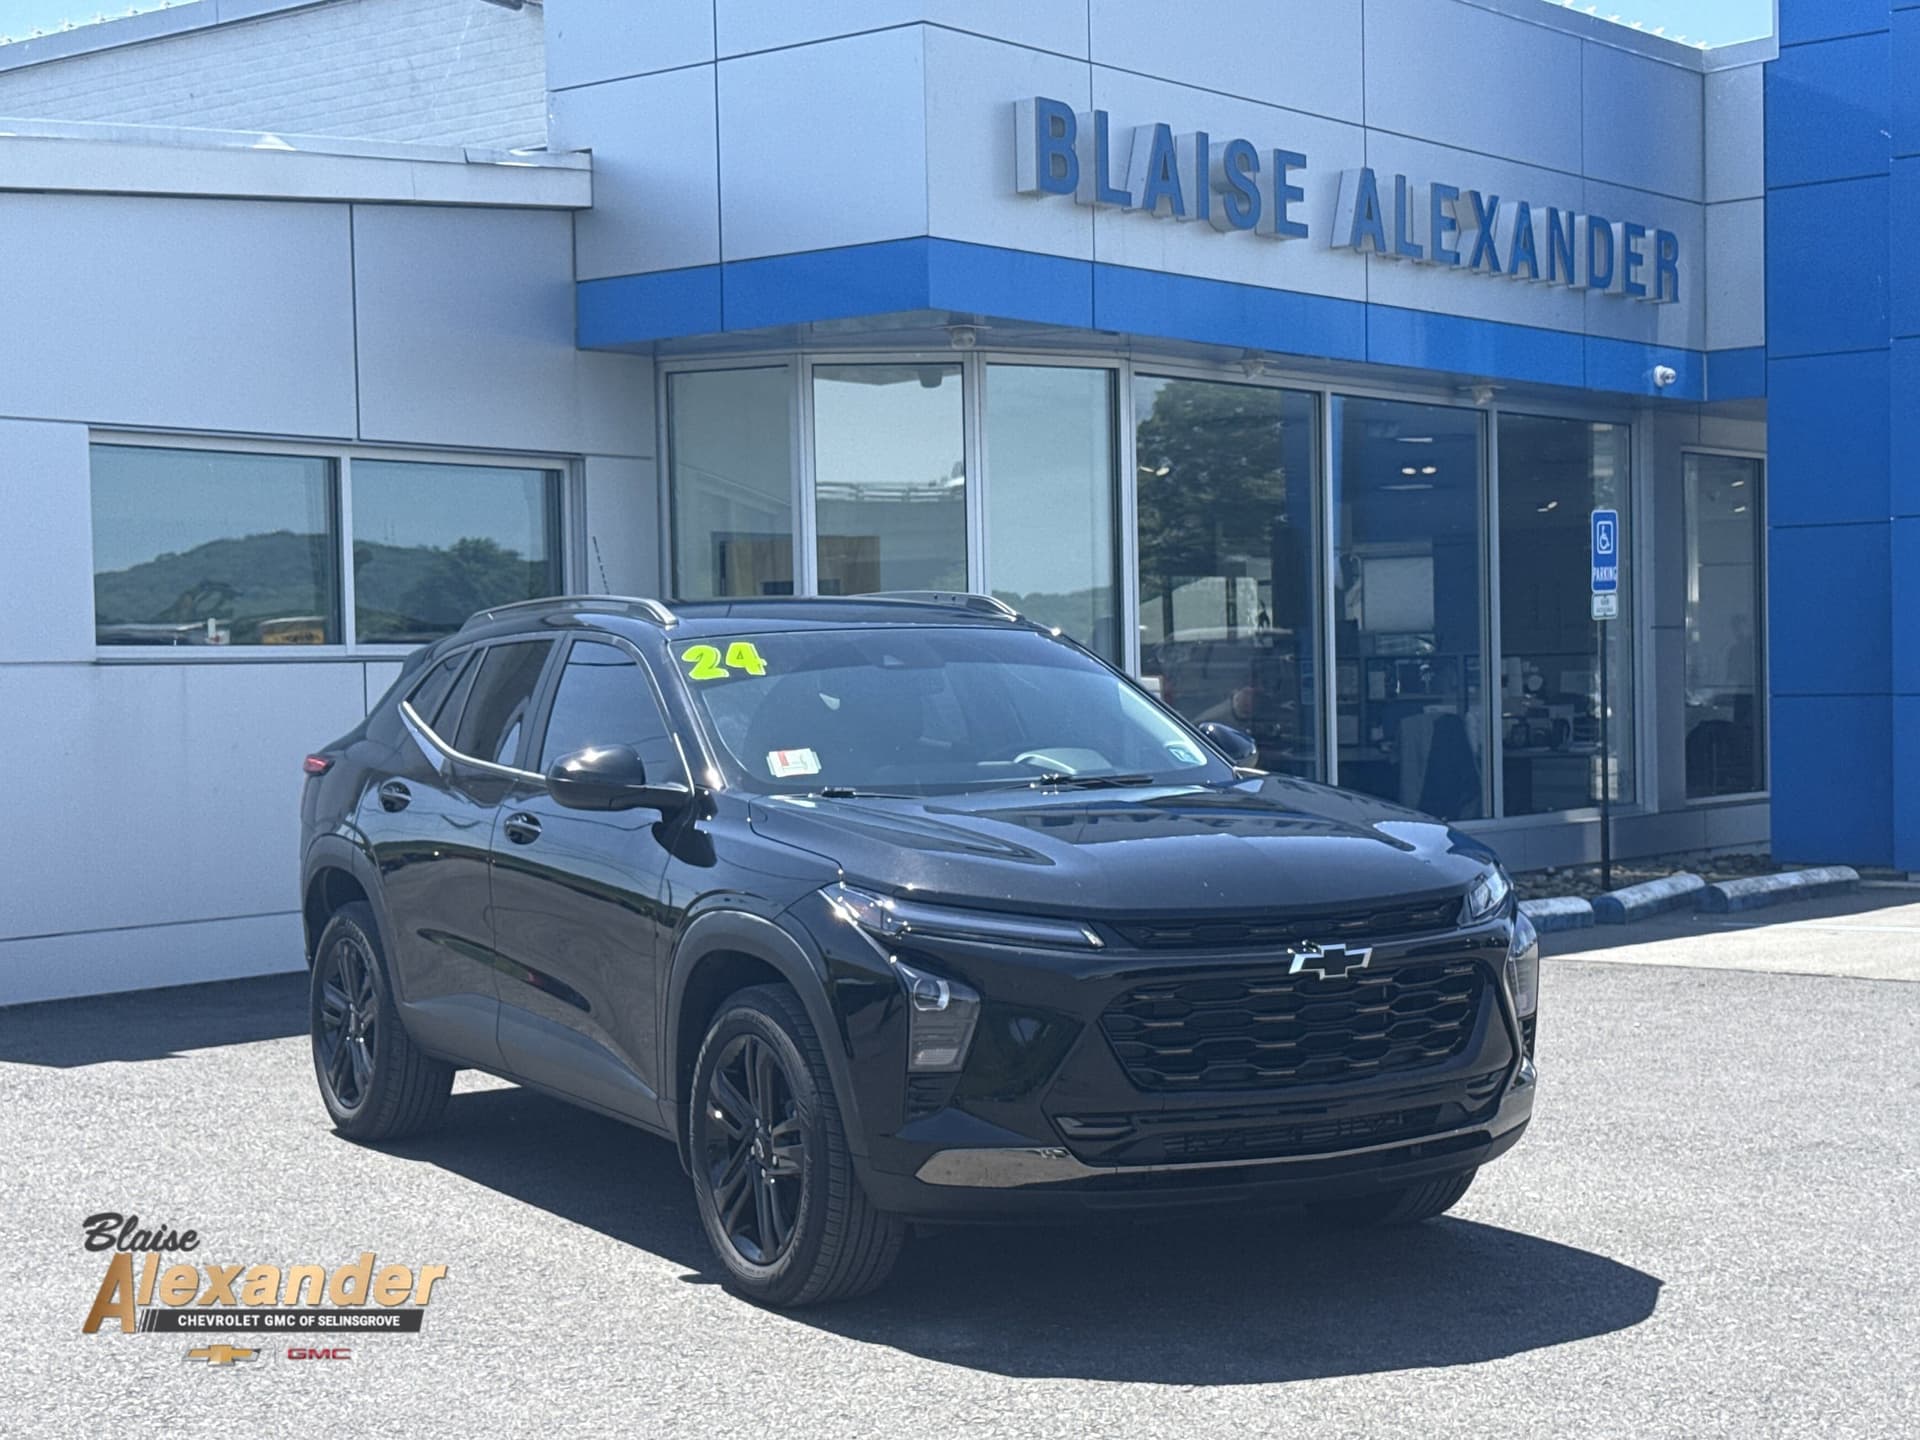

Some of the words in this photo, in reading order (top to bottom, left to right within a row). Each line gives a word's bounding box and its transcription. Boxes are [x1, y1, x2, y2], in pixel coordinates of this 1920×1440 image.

[1030, 96, 1309, 240] BLAISE
[1345, 166, 1680, 302] ALEXANDER
[1591, 566, 1617, 581] PARKING
[681, 642, 767, 680] 24
